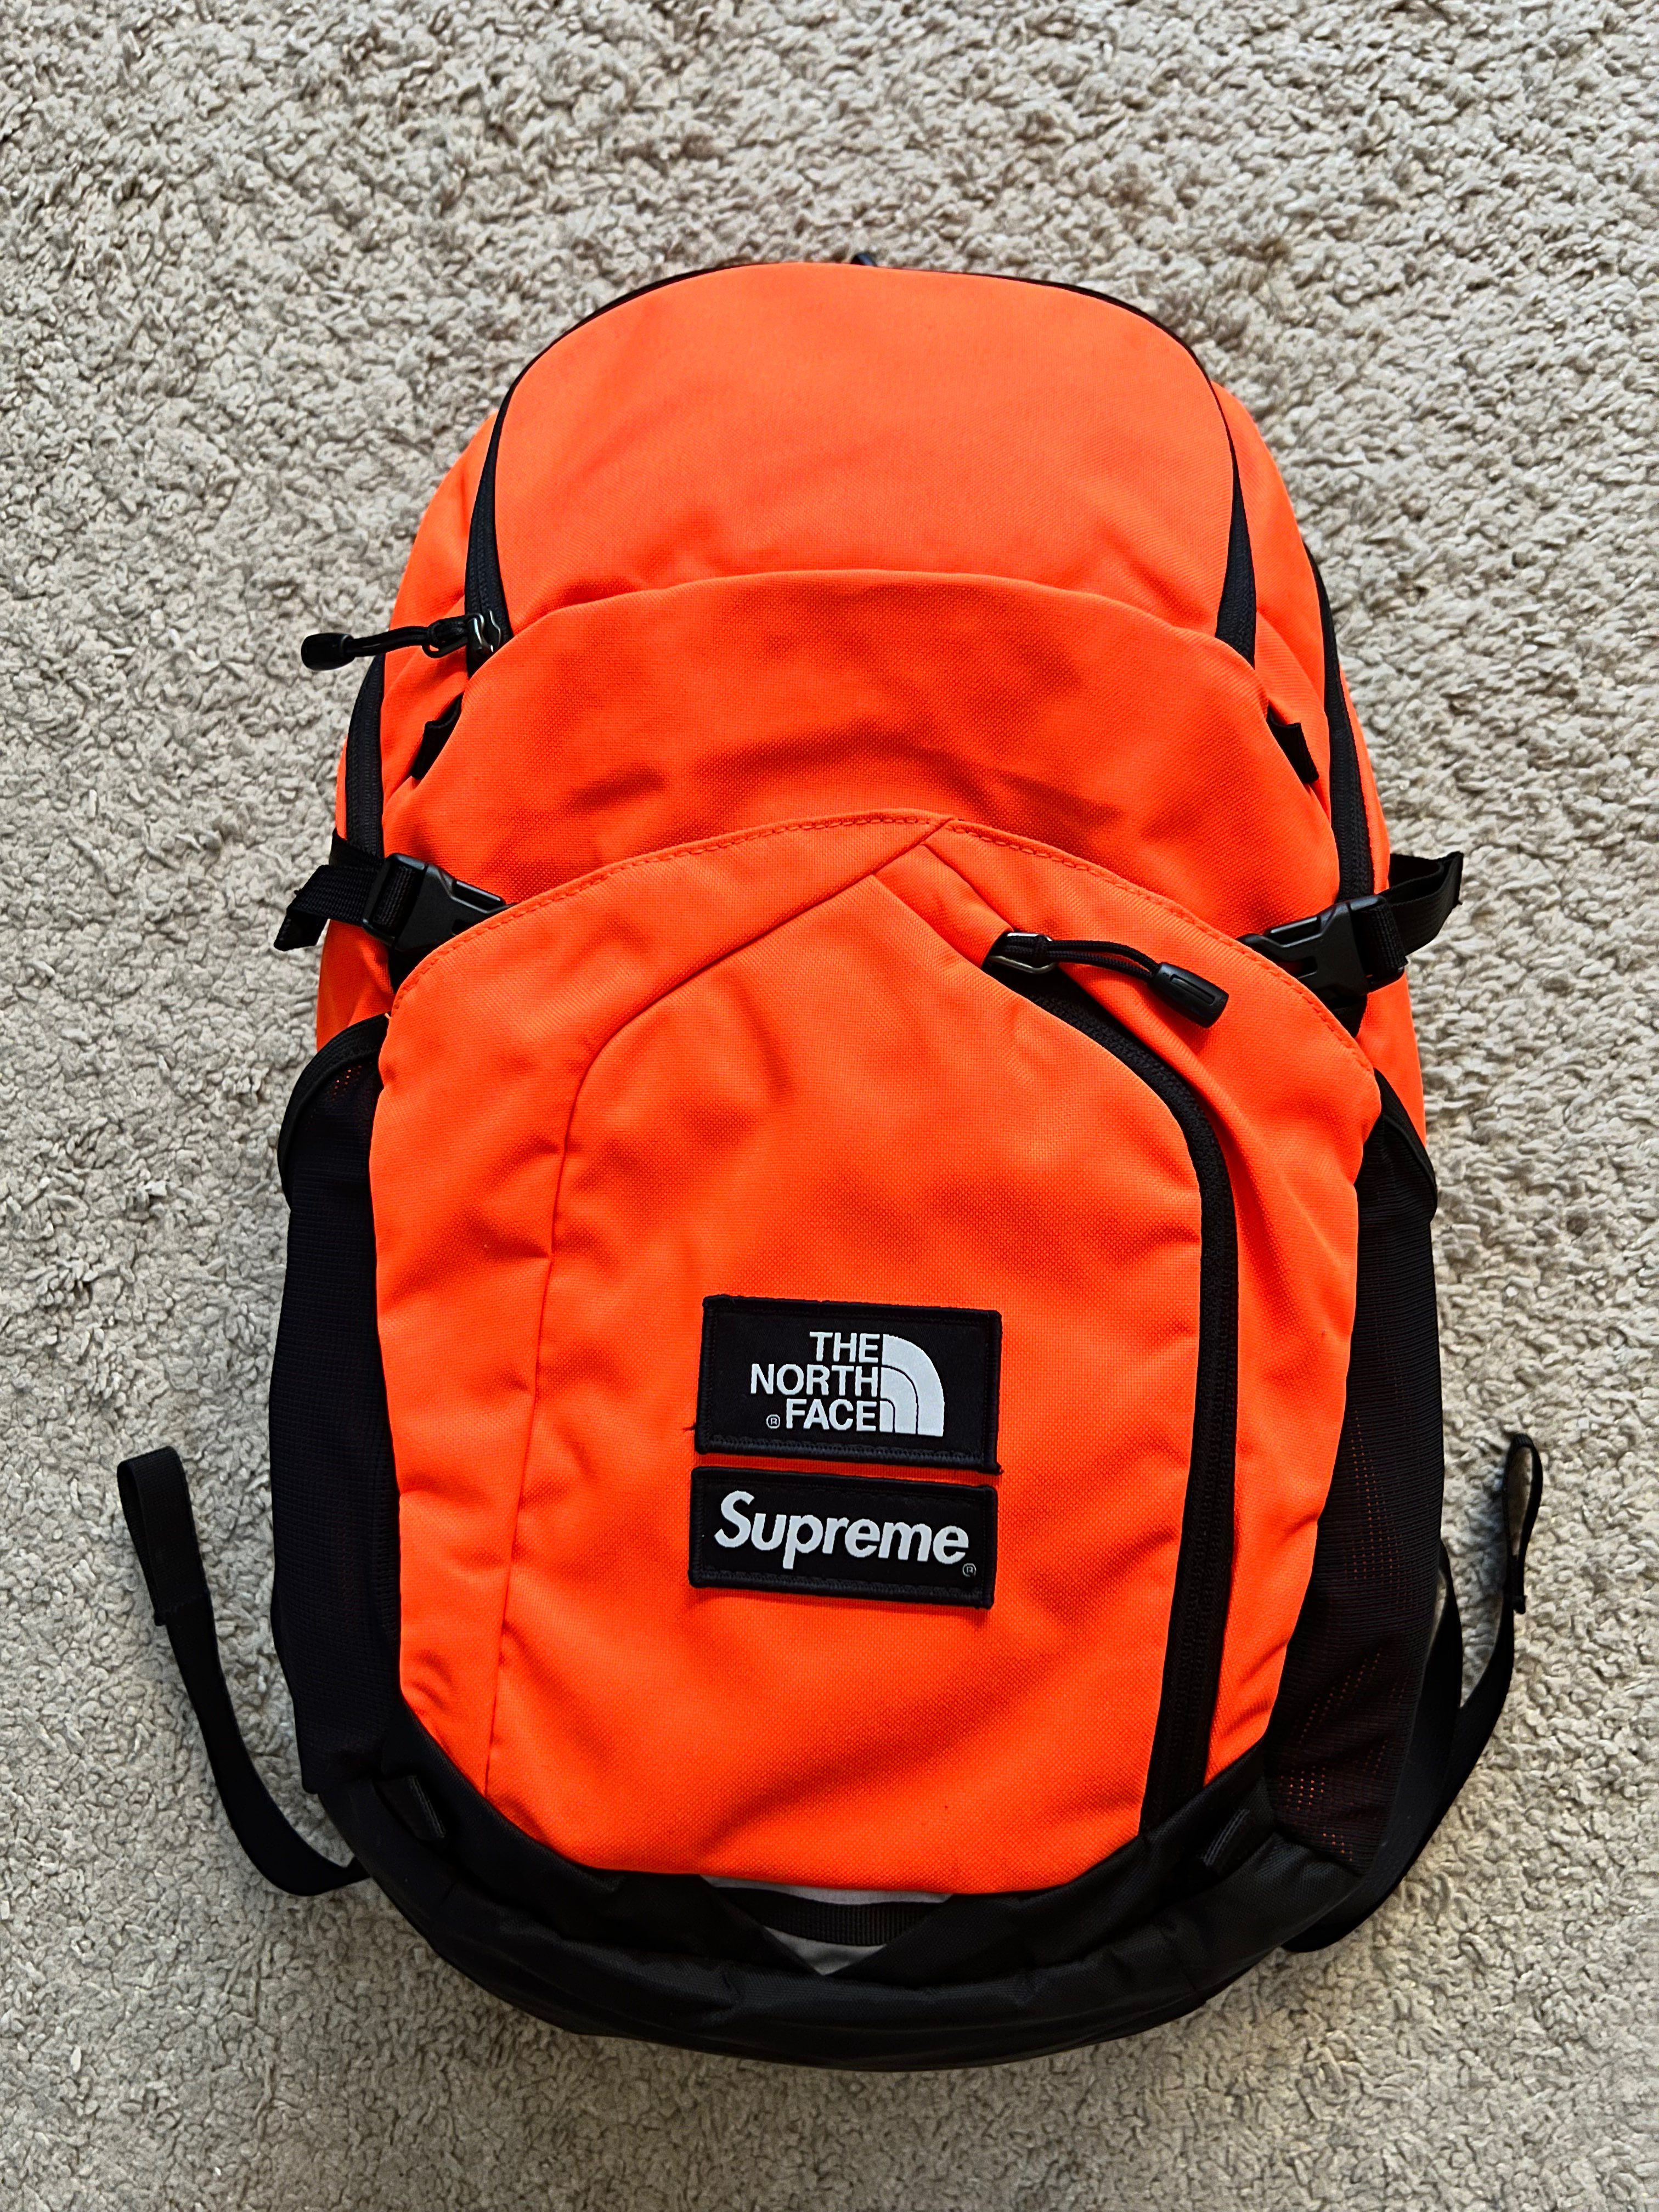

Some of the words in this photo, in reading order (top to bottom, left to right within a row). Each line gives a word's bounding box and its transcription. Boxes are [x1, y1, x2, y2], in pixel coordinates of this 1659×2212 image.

[809, 1331, 881, 1363] THE
[750, 1363, 878, 1397] NORTH
[786, 1398, 877, 1431] FACE
[714, 1490, 969, 1570] Supreme
